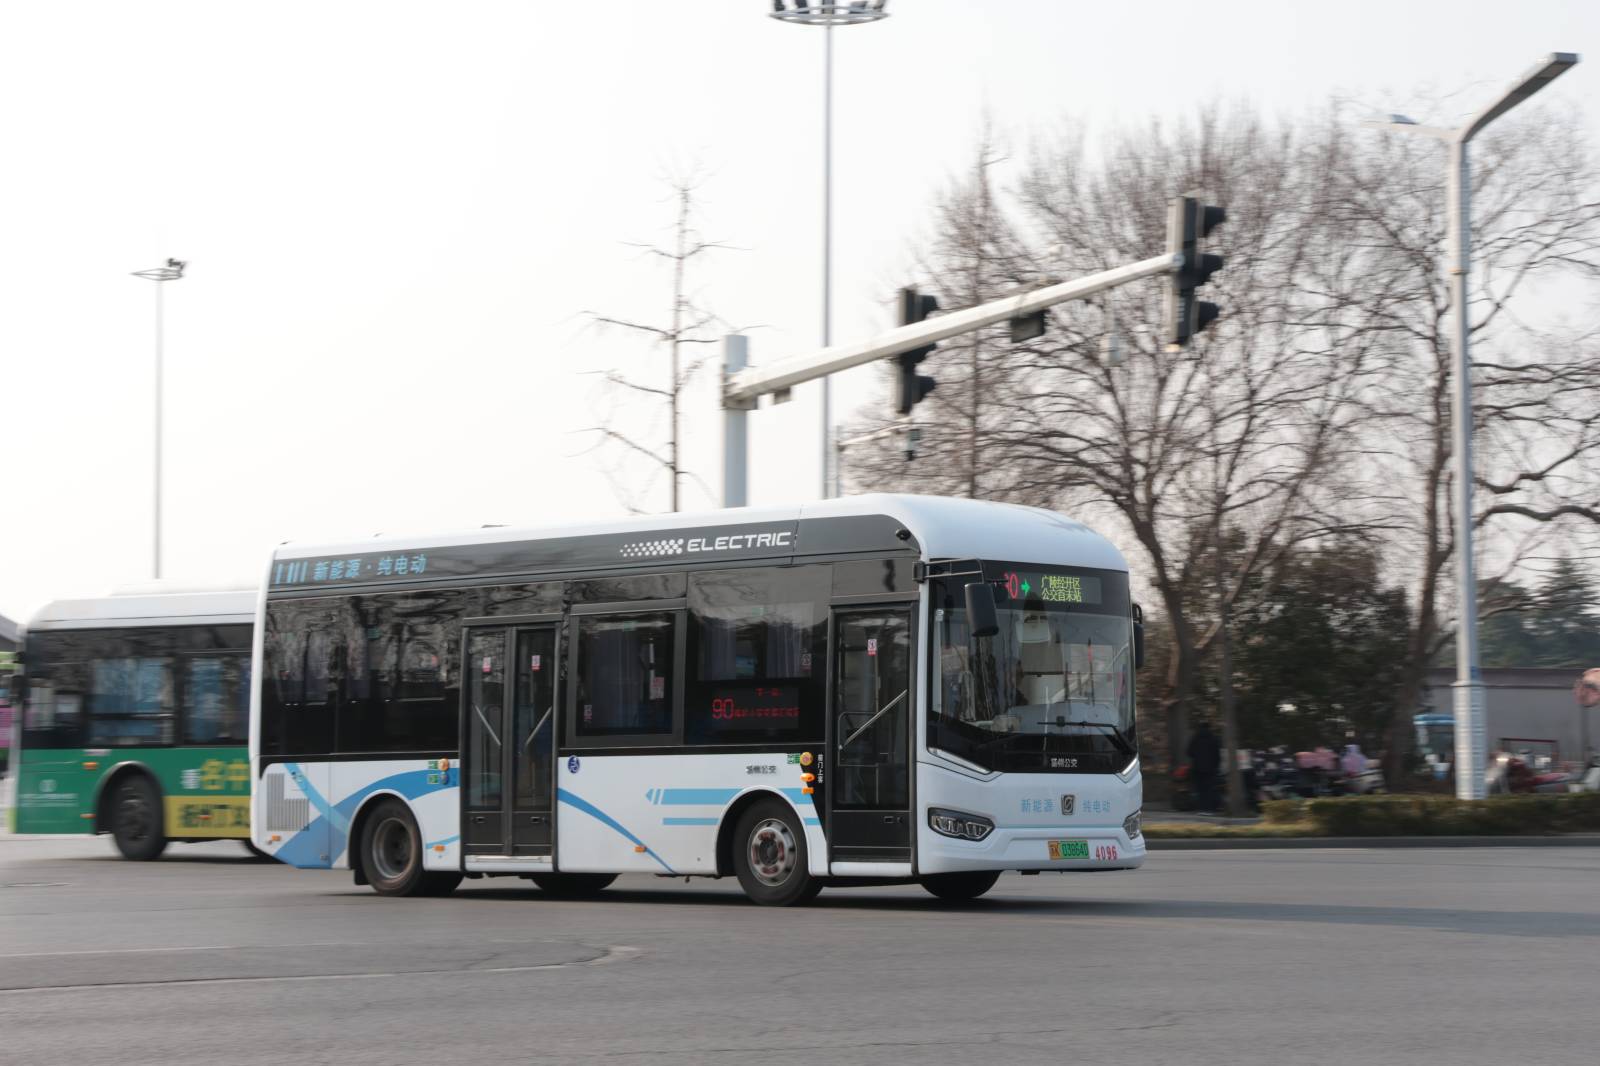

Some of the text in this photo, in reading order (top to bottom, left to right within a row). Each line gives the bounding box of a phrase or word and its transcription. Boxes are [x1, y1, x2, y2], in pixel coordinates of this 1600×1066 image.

[686, 531, 792, 552] ELECTRIC
[712, 697, 734, 720] 90
[1021, 798, 1111, 813] 新能源 纯电动
[1095, 845, 1118, 860] 4096
